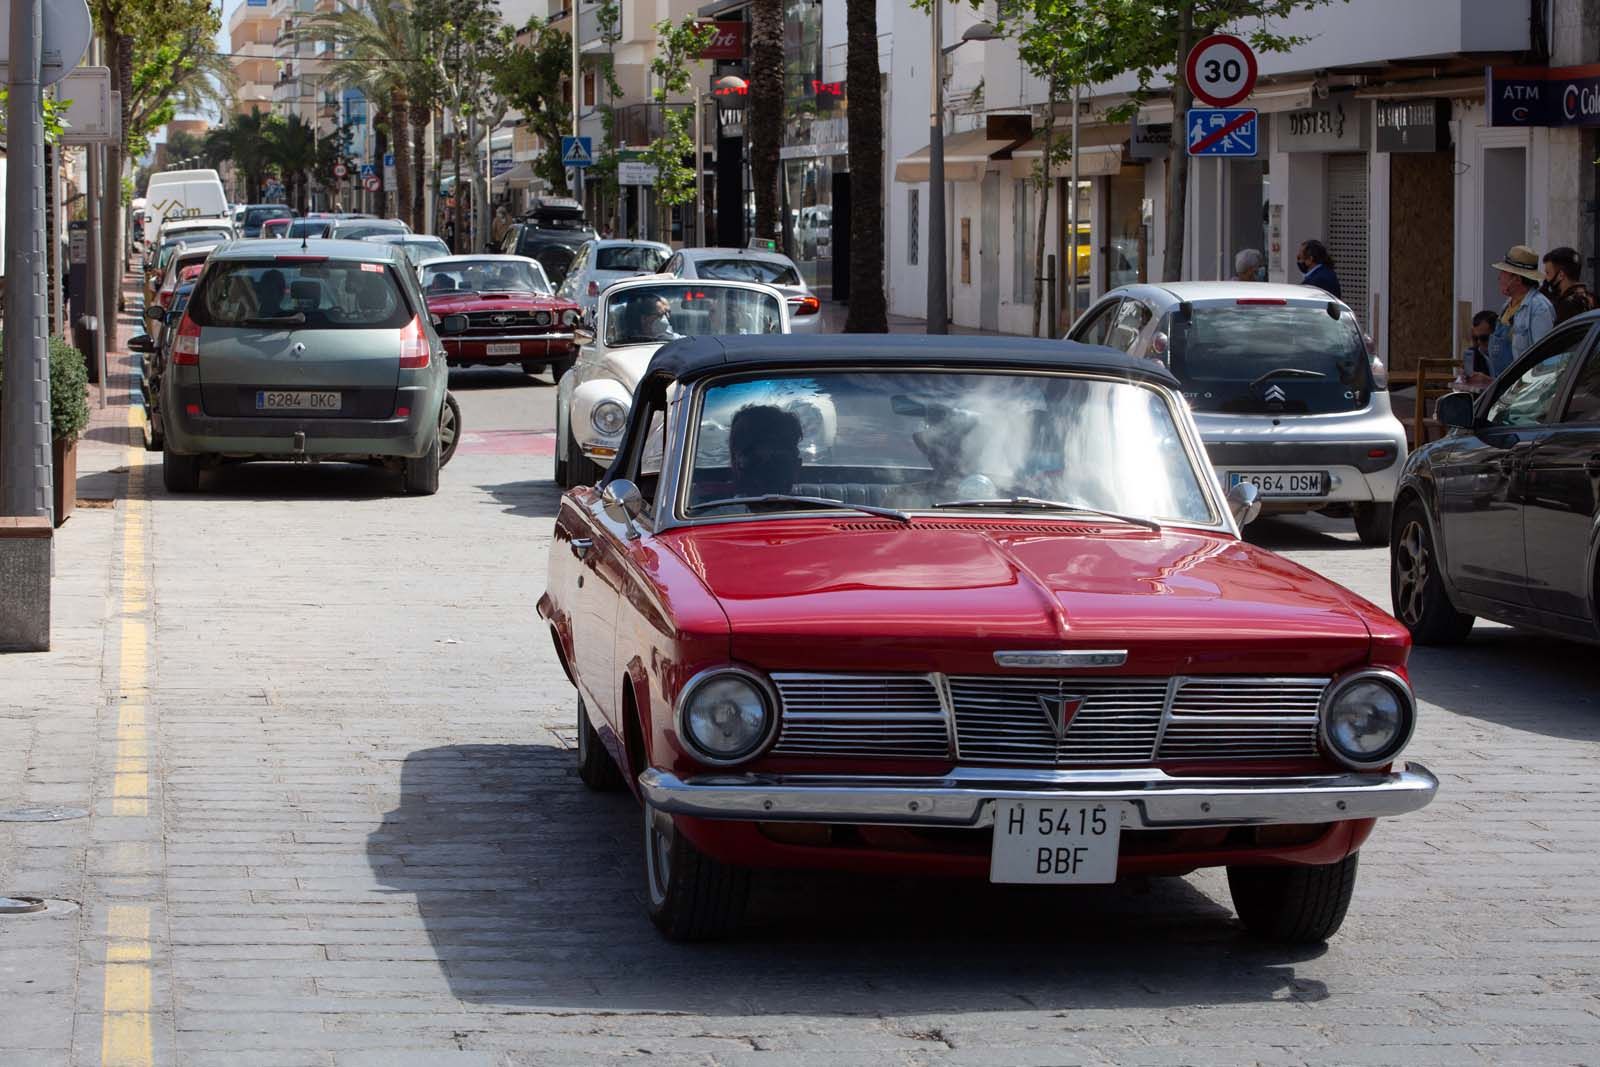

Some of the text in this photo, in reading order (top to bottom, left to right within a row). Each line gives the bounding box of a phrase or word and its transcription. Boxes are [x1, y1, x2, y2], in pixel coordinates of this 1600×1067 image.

[1204, 59, 1241, 83] 30
[1503, 85, 1539, 99] ATM
[1288, 112, 1332, 136] DISTEL
[267, 393, 336, 407] 6284 DKC
[1290, 476, 1319, 490] DSM
[1008, 808, 1107, 836] H 5415
[1036, 847, 1089, 874] BBF
